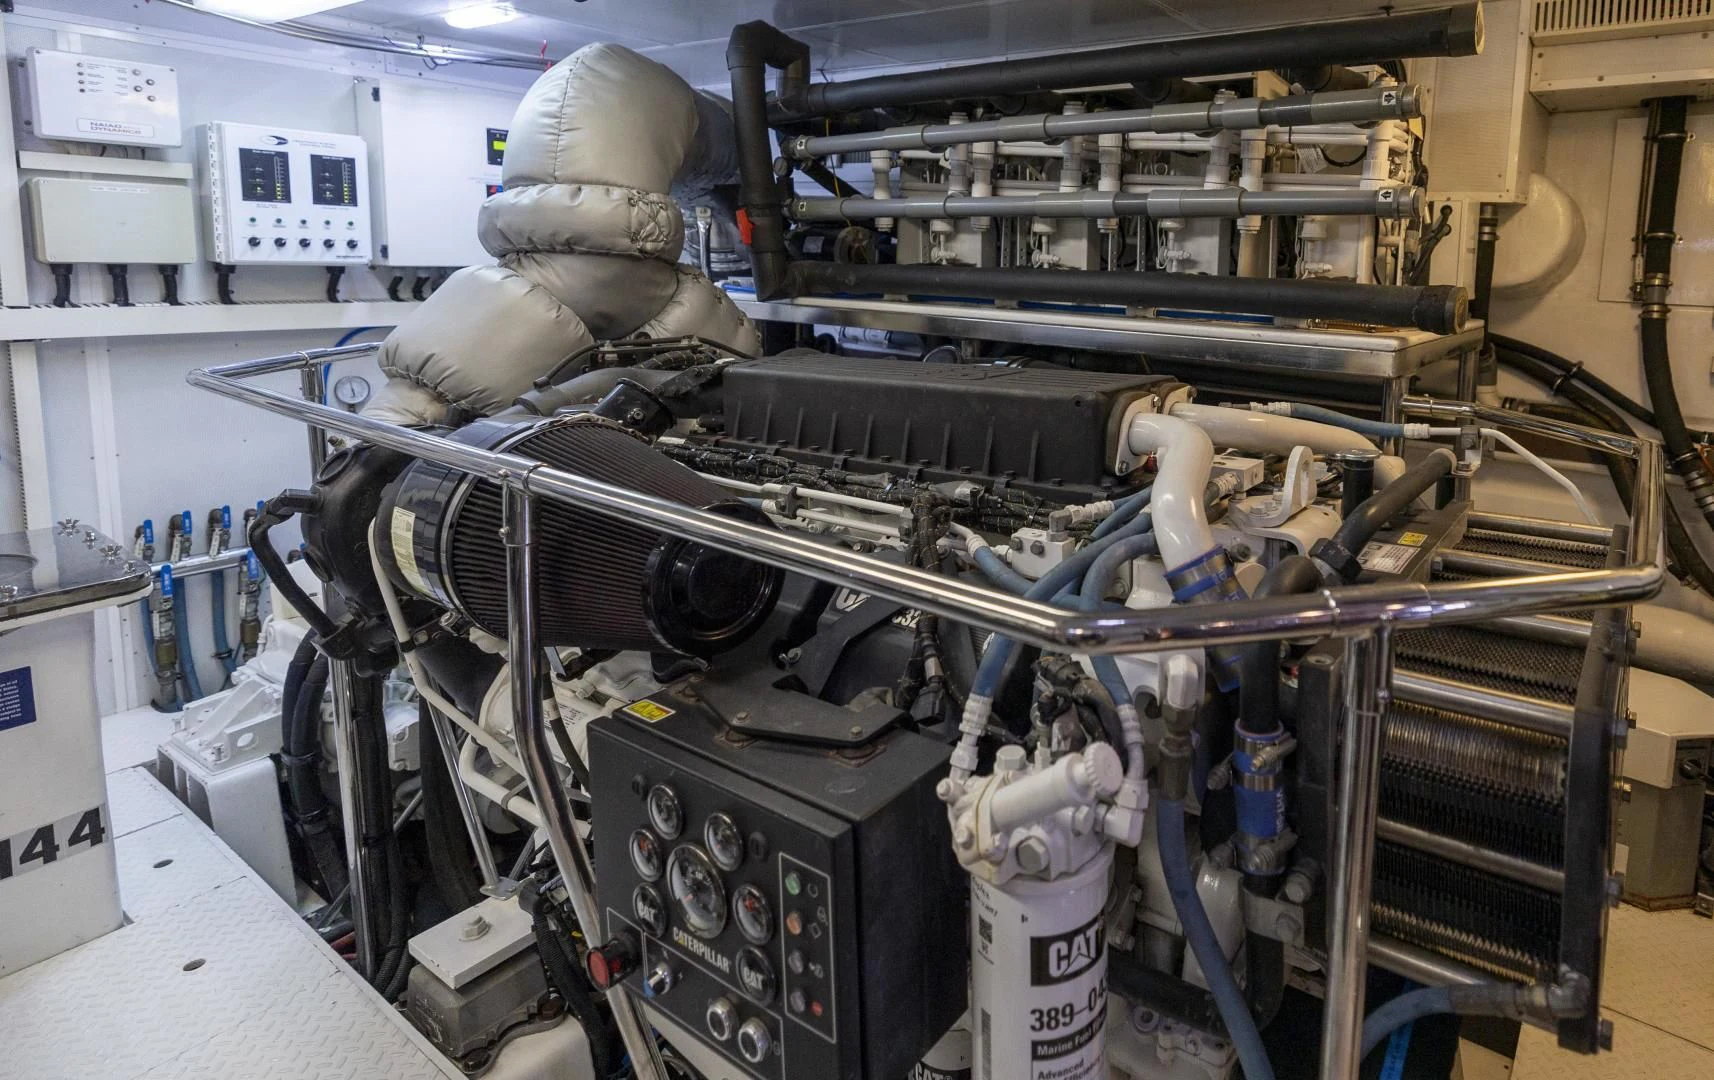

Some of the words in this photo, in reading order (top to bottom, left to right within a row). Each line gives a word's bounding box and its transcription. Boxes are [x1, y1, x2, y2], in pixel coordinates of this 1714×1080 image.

[637, 901, 657, 923] CAT
[673, 926, 730, 974] CATERPILLAR
[1048, 923, 1098, 979] CAT
[743, 966, 766, 990] CAT
[1030, 976, 1108, 1032] 389-04
[1037, 1041, 1073, 1056] Marine
[1038, 1057, 1085, 1080] Advanced
